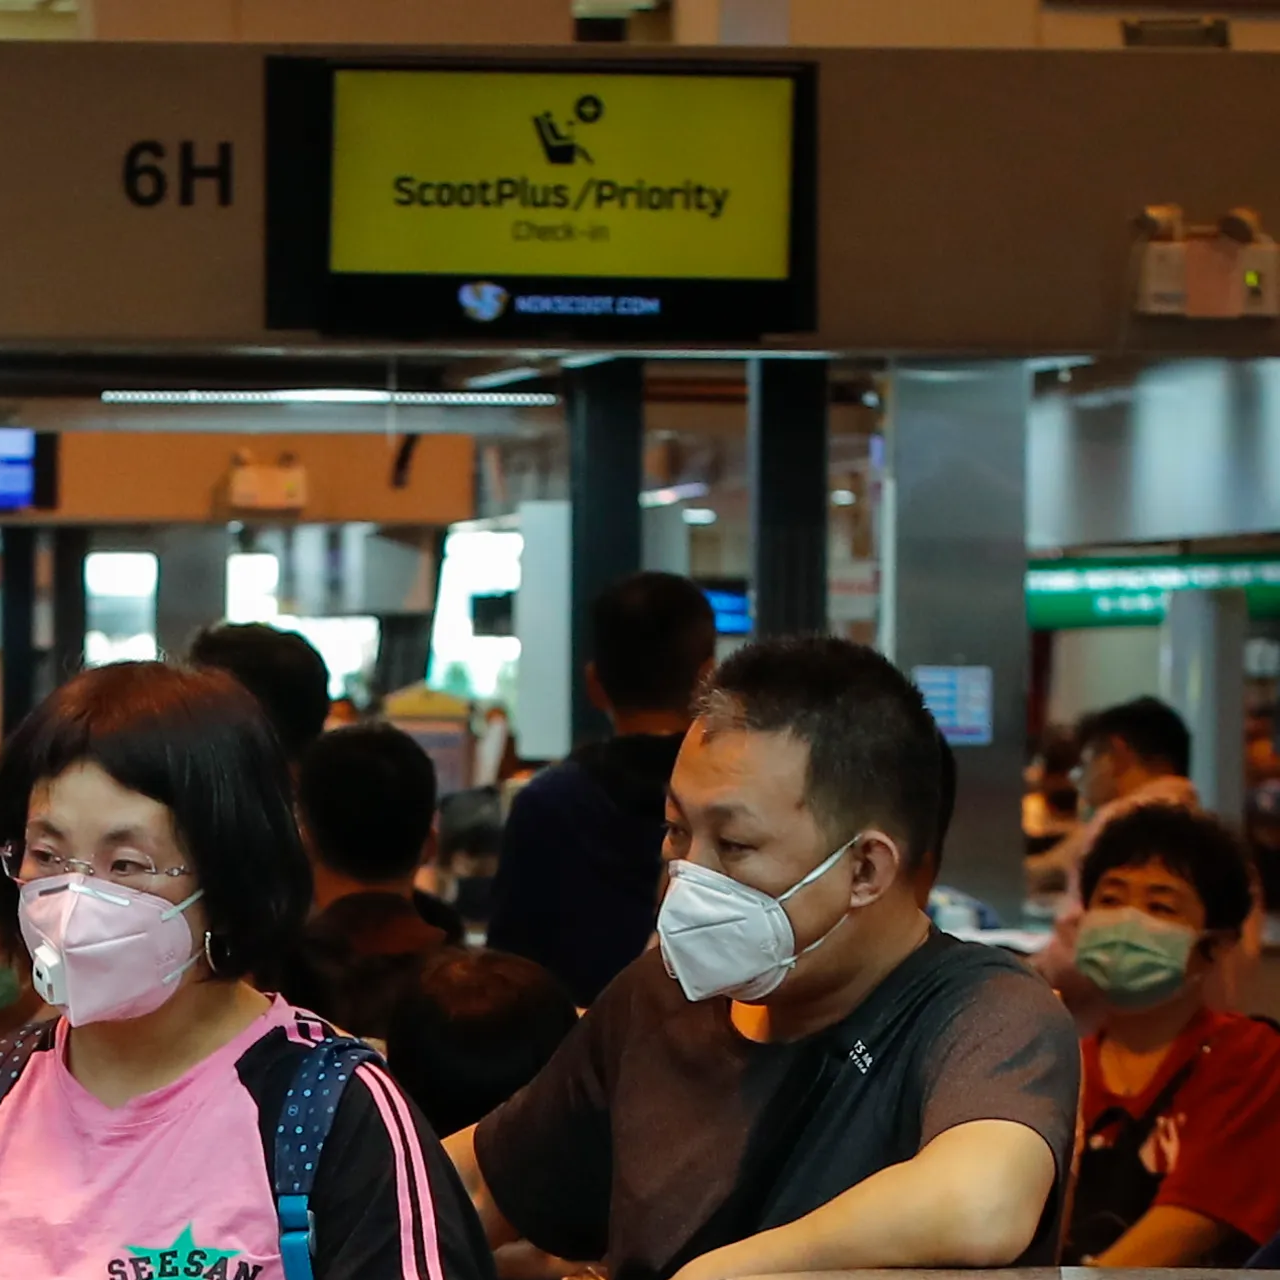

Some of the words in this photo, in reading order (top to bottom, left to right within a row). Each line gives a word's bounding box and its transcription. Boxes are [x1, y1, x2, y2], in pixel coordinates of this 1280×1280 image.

[122, 140, 234, 208] 6H
[392, 175, 731, 218] ScootPlus/Priority
[511, 219, 611, 243] Check-in
